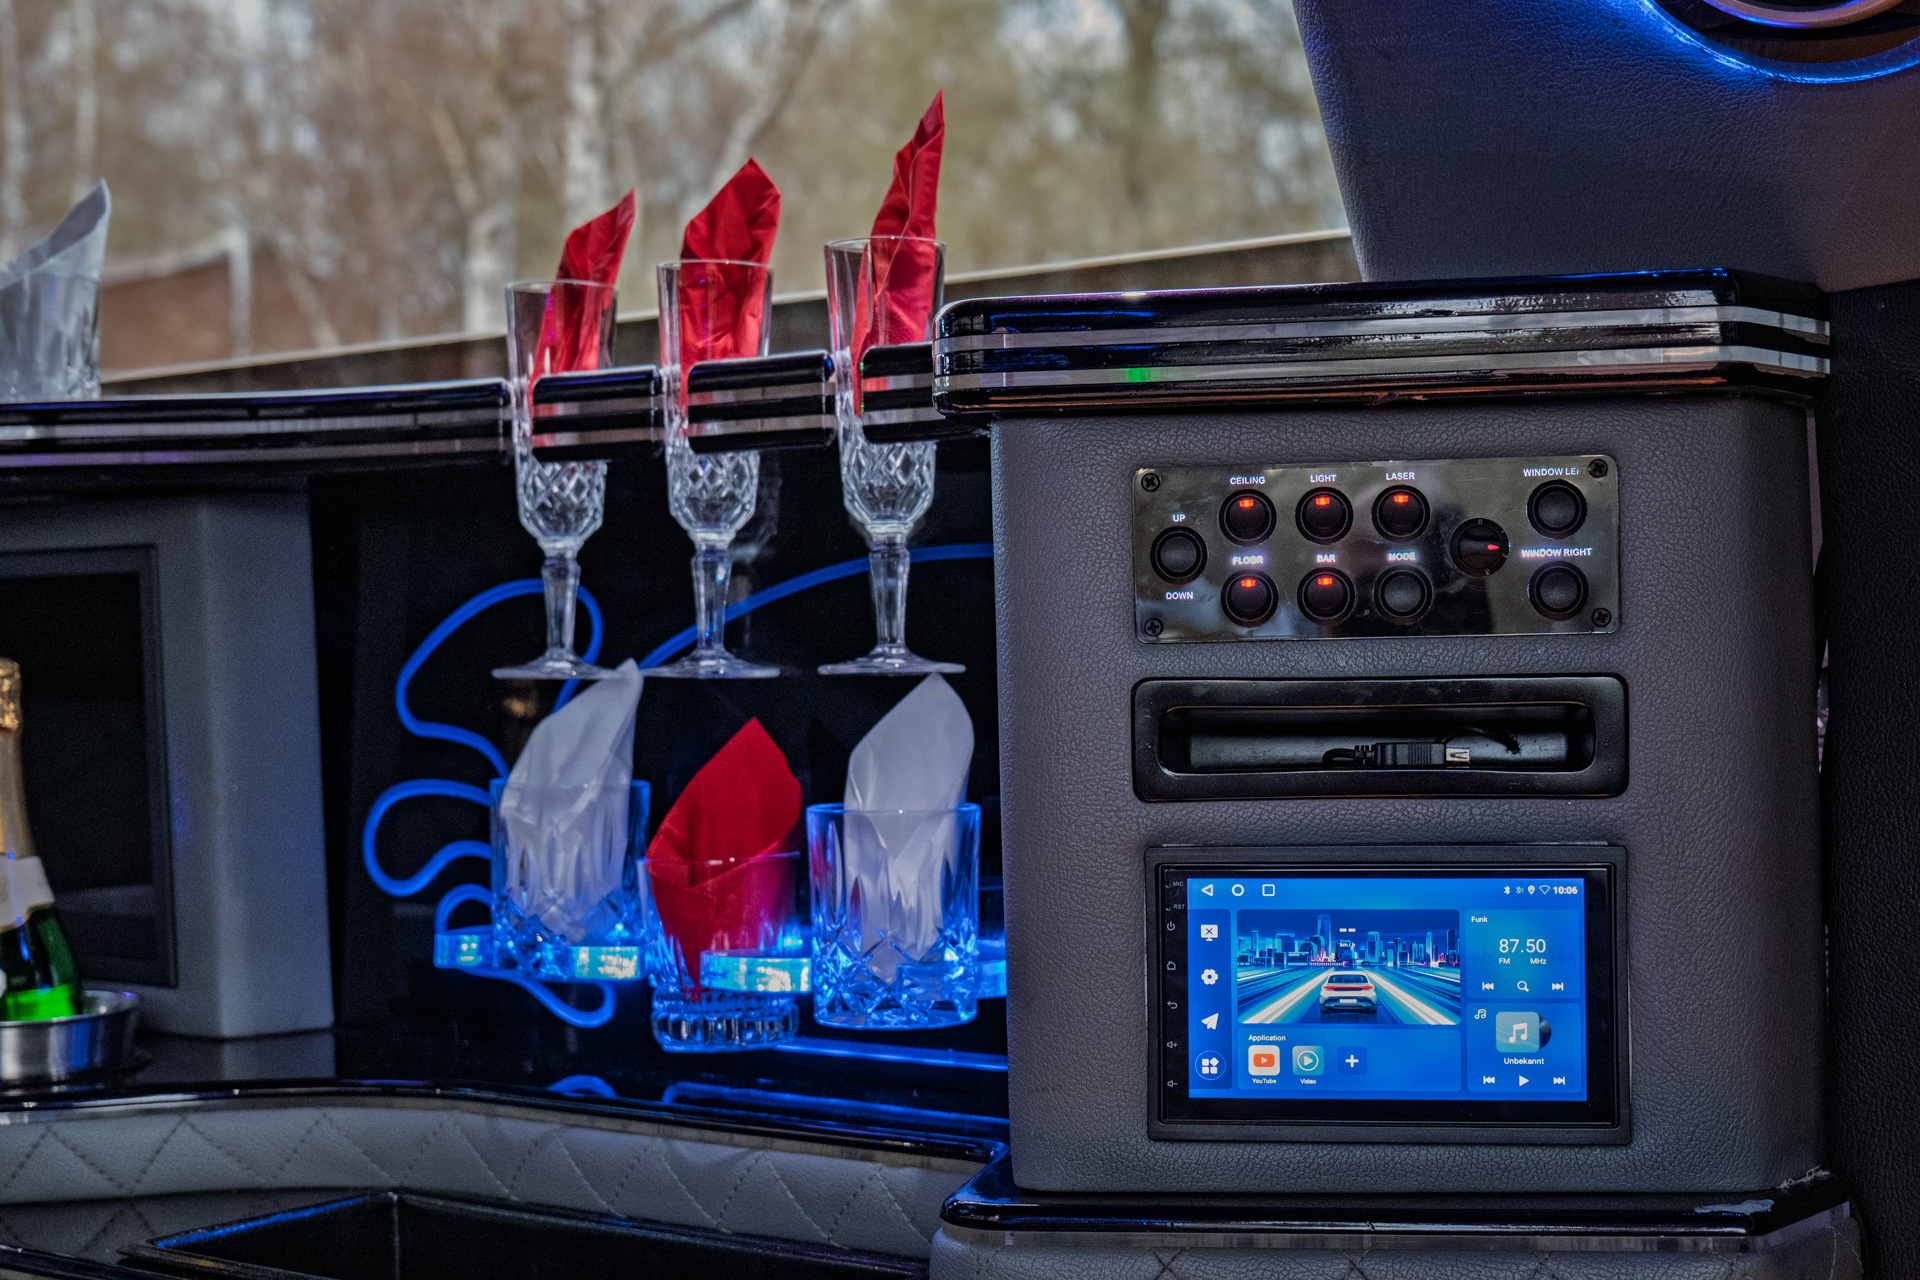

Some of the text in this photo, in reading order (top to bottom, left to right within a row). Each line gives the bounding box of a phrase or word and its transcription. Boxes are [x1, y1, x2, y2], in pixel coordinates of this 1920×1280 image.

[1385, 471, 1416, 481] LASER
[1522, 467, 1563, 477] WINDOW
[1229, 476, 1266, 485] CEILING
[1310, 473, 1337, 483] LIGHT
[1172, 513, 1186, 522] UP
[1387, 551, 1416, 562] MODE
[1521, 547, 1593, 558] WINDOW RIGHT
[1231, 555, 1264, 565] FLOOR
[1316, 553, 1336, 563] BAR
[1165, 591, 1194, 600] DOWN
[1553, 886, 1578, 895] 10:06
[1471, 915, 1488, 923] Funk
[1499, 938, 1546, 954] 87.50
[1498, 957, 1511, 965] FM
[1530, 957, 1547, 965] MHz
[1248, 1034, 1286, 1042] Application
[1503, 1057, 1545, 1065] Unbekannt
